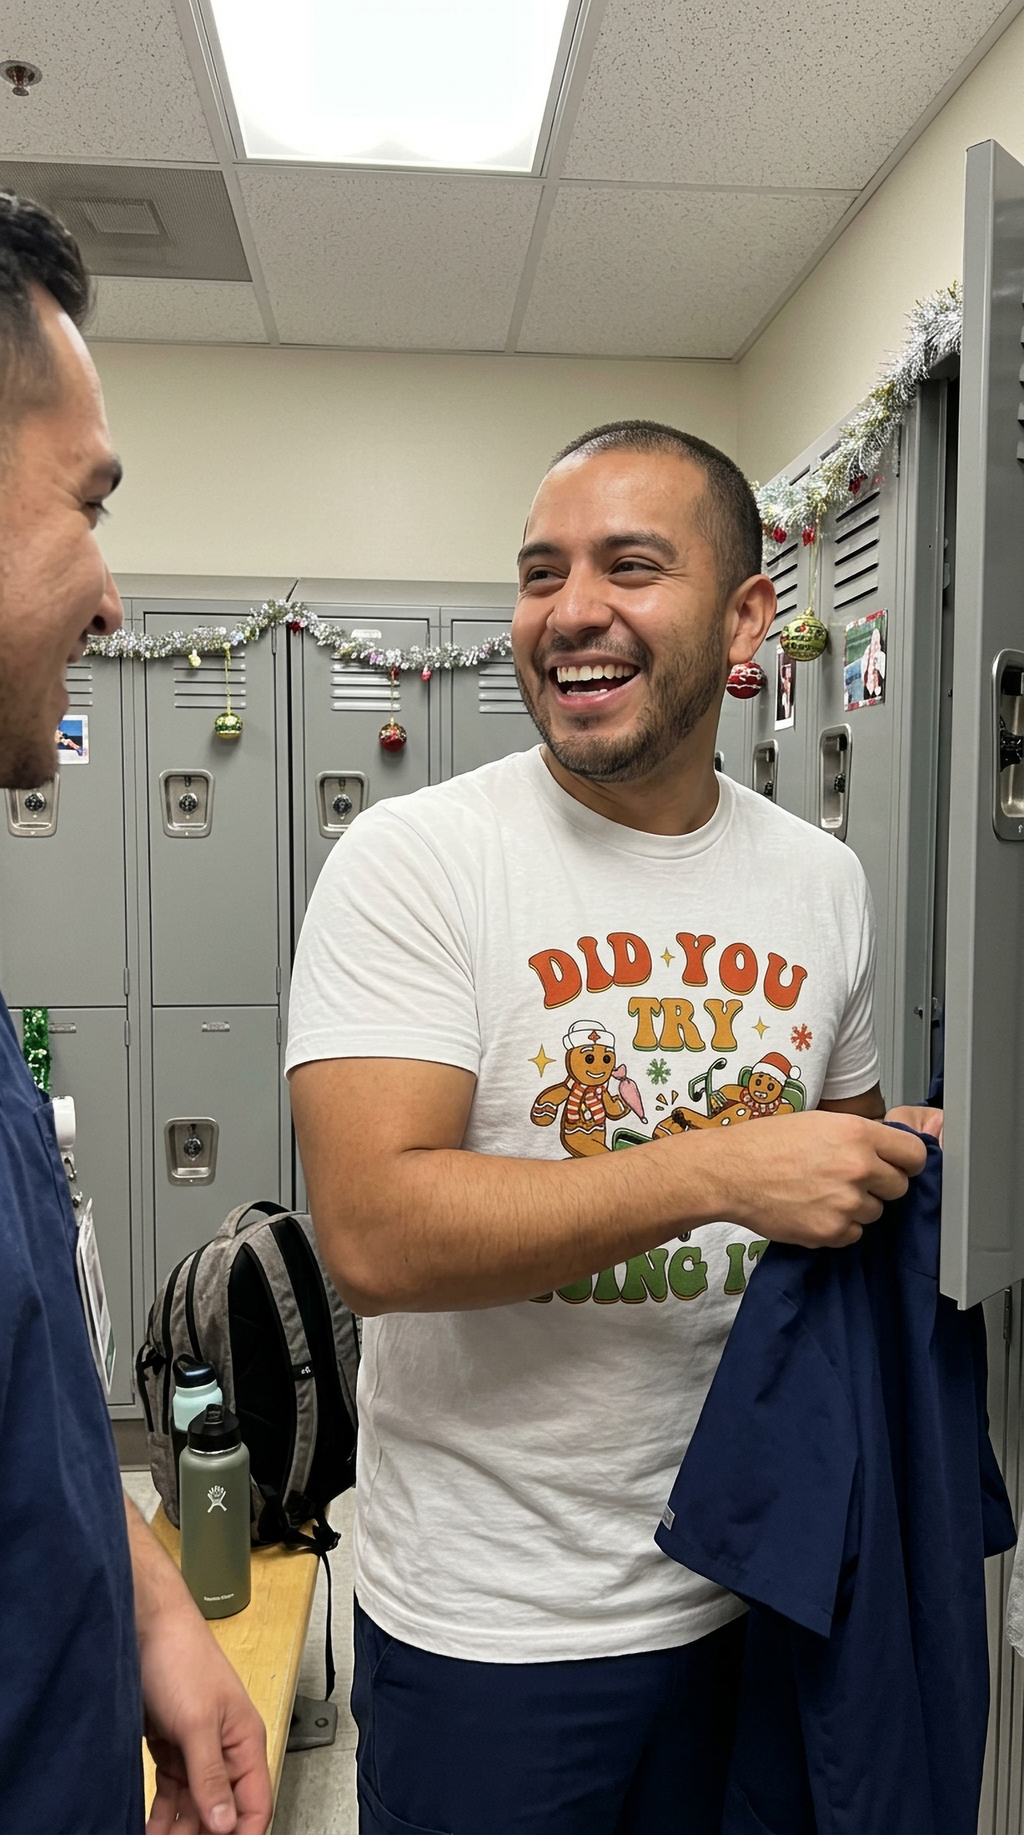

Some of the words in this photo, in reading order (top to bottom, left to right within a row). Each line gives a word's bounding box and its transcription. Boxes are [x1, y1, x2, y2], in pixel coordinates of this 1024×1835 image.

[528, 932, 653, 1010] DID
[676, 932, 808, 1011] YOU
[627, 996, 743, 1052] TRY
[529, 1247, 708, 1305] ING
